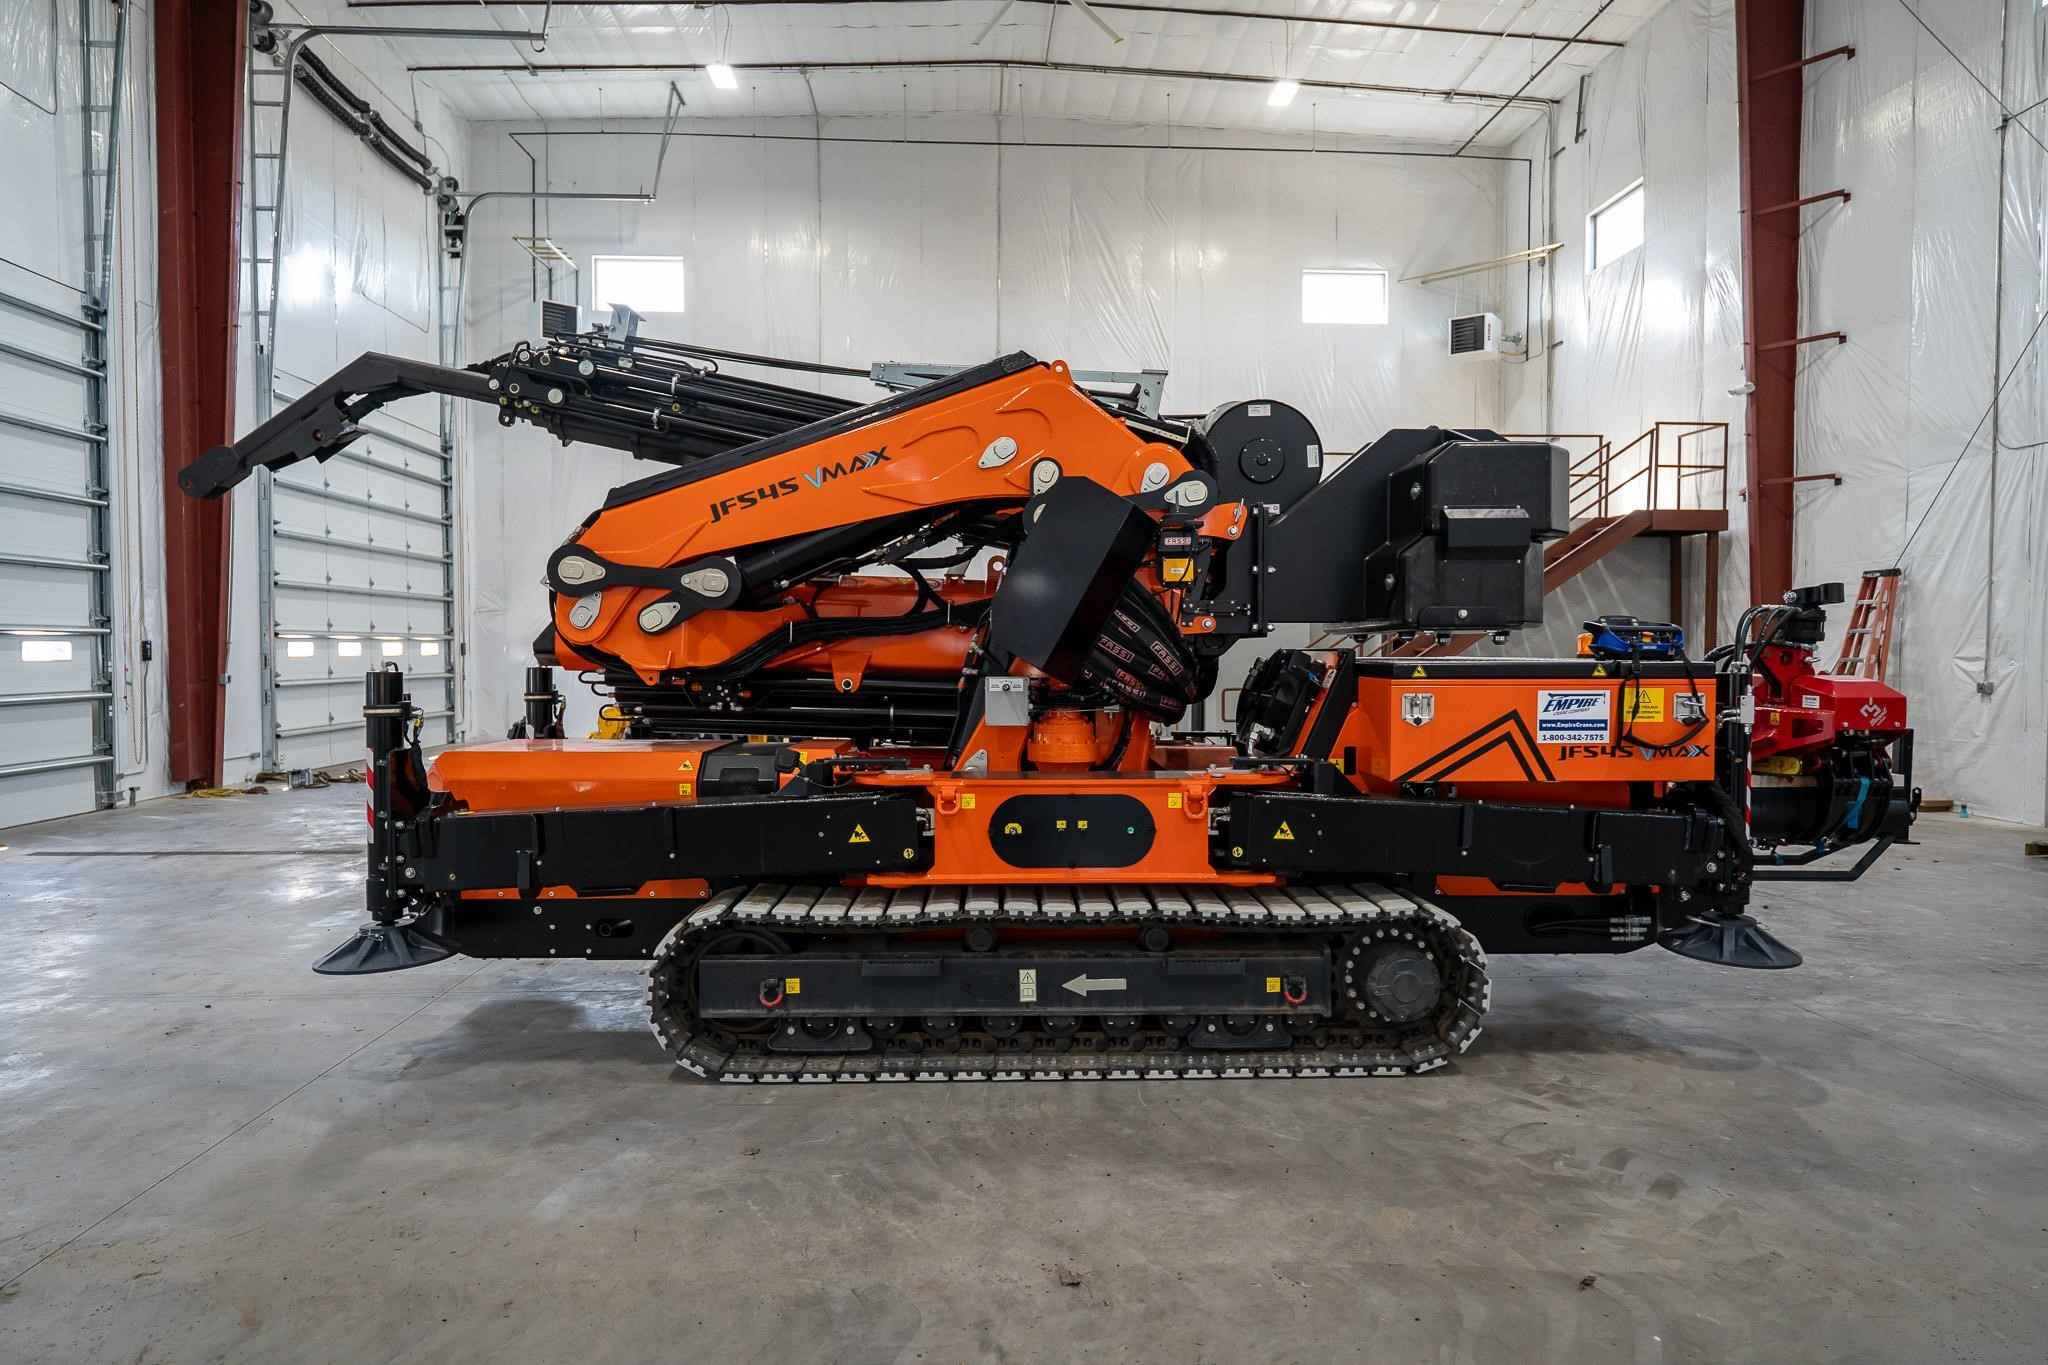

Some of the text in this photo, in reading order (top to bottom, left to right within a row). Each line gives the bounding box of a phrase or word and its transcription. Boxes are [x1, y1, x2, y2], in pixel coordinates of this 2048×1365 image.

[803, 446, 892, 488] VMAX
[1152, 643, 1181, 673] FASSI
[1542, 698, 1601, 713] EMPIRE
